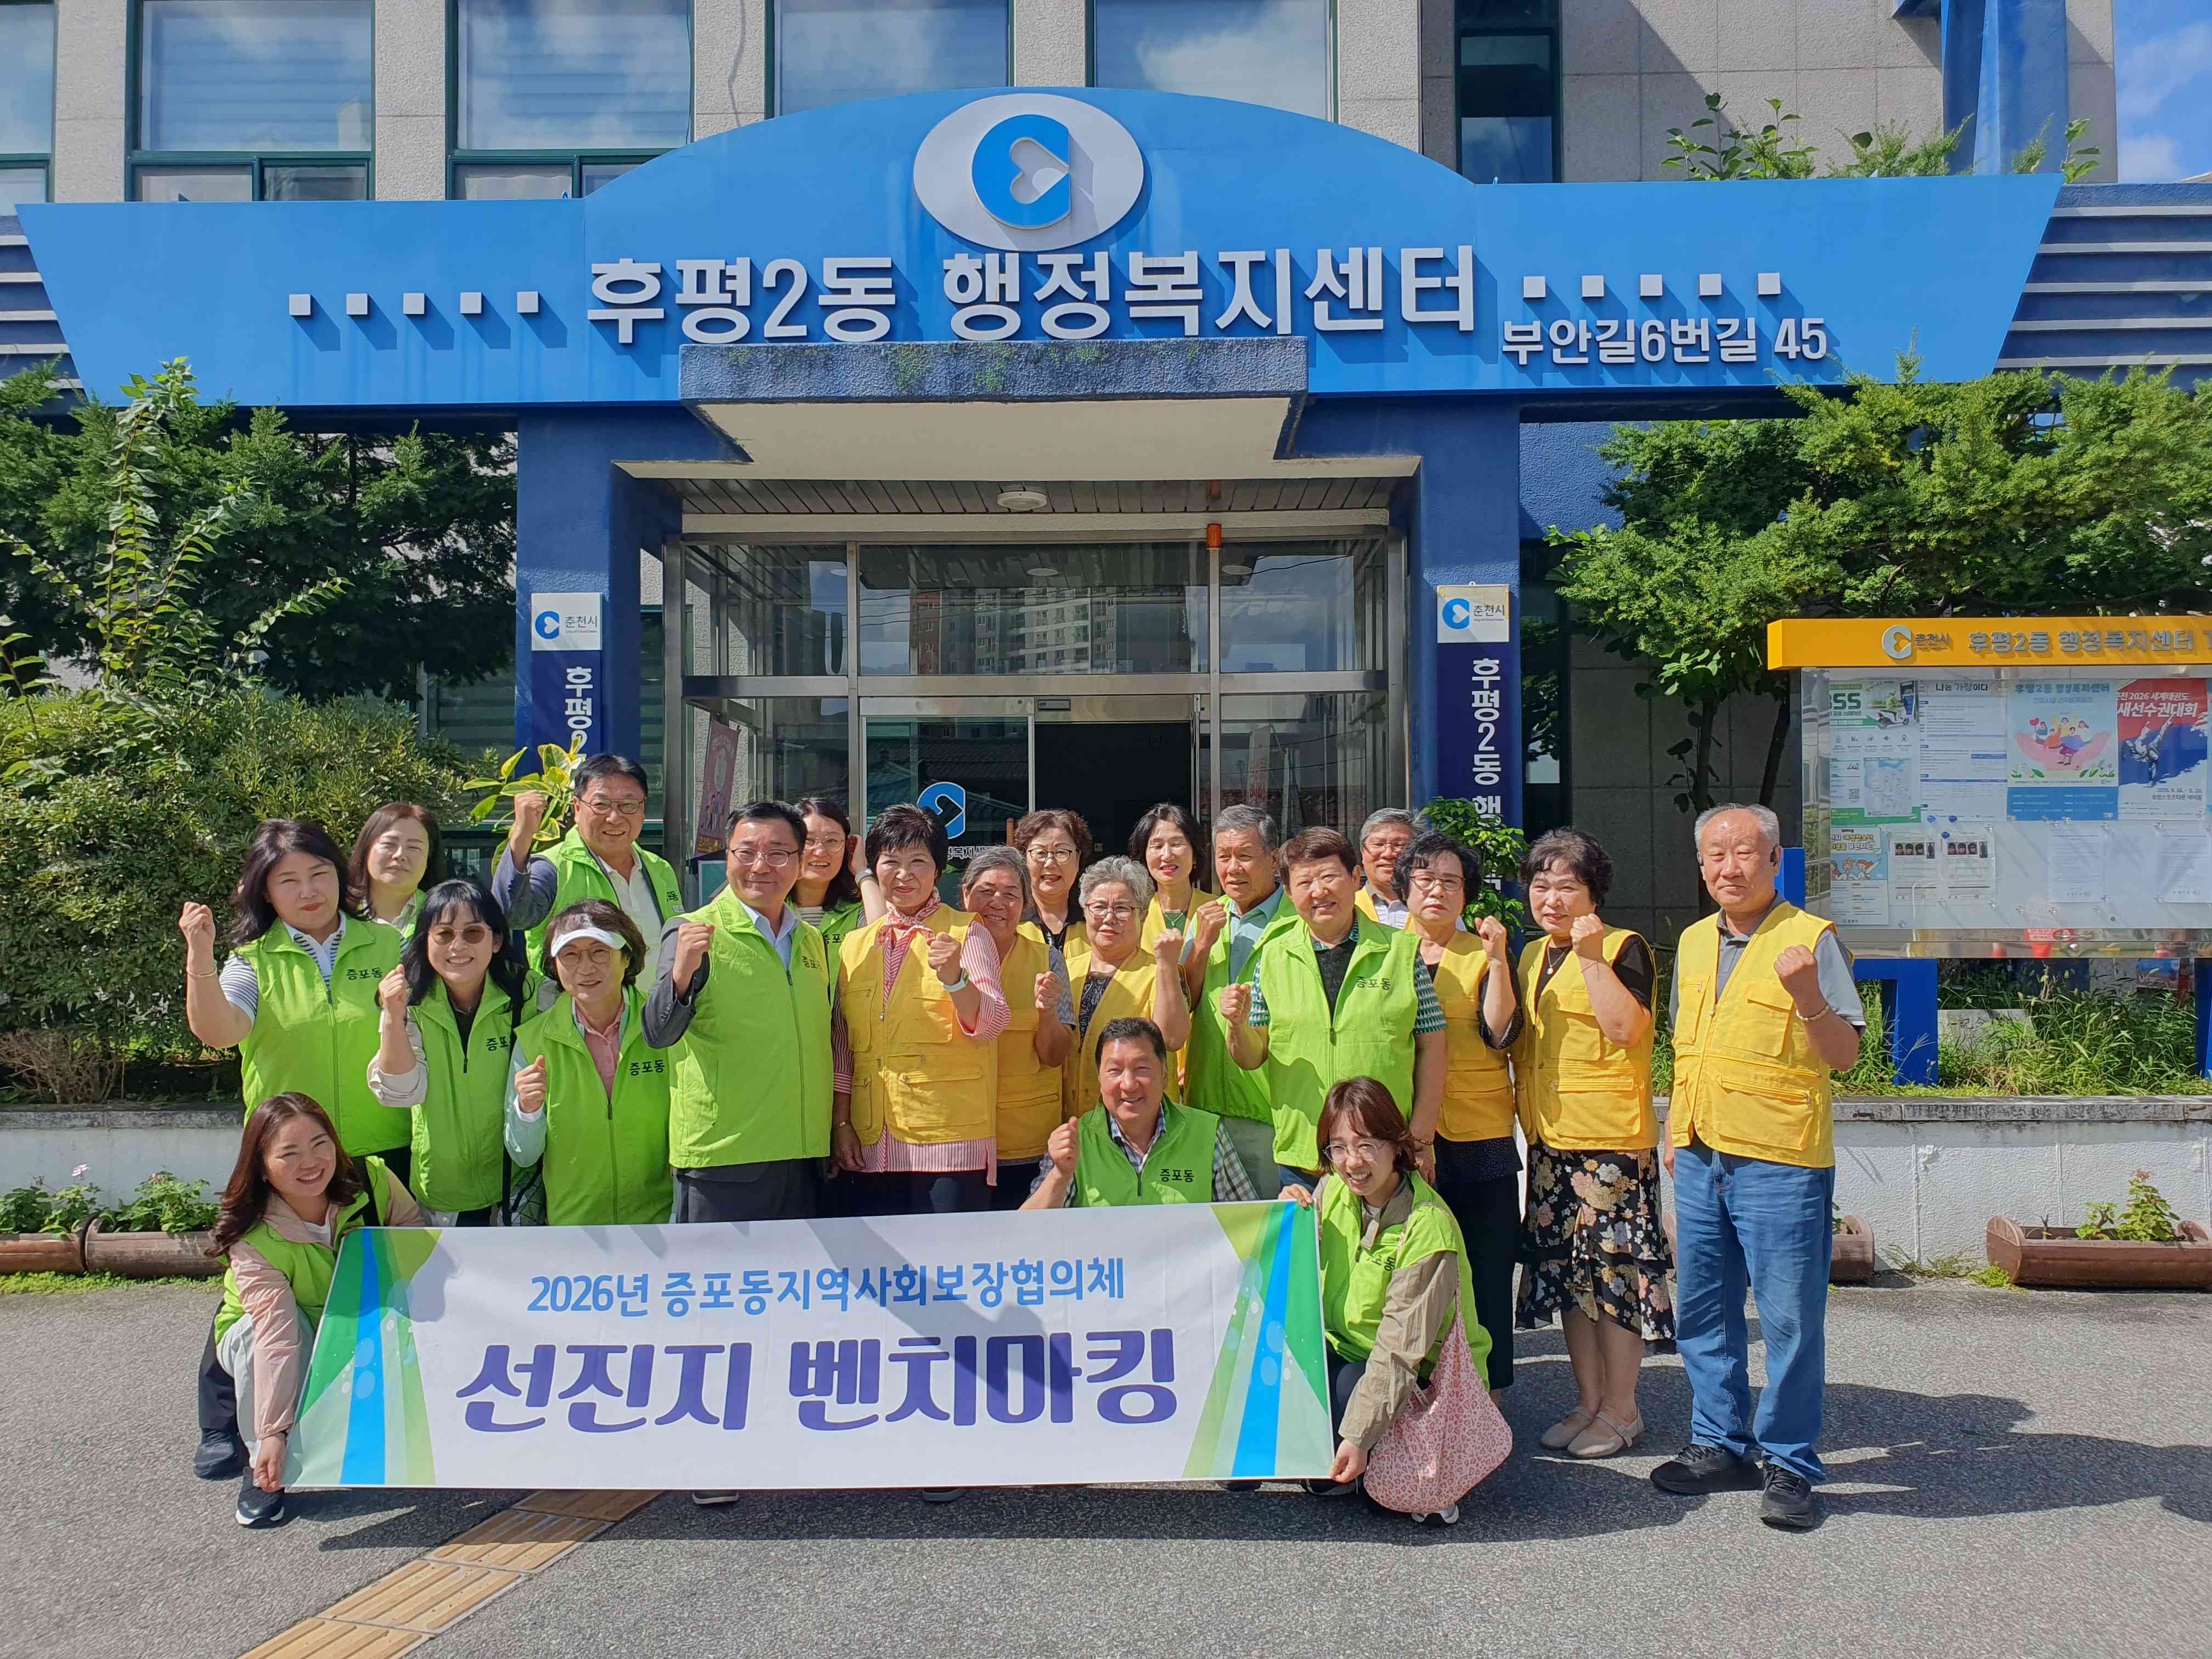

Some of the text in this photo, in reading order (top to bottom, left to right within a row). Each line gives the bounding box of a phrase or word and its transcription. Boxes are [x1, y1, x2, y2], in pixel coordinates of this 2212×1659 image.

[587, 245, 1474, 344] 후평2동 행정복지센터
[1502, 318, 1827, 365] 부안길6번길 45
[1473, 604, 1505, 616] 춘천시
[565, 616, 597, 628] 춘천시
[1968, 631, 2049, 652] 후평2동
[2058, 630, 2194, 652] 행정복지센터
[2129, 692, 2149, 700] 2026
[1471, 658, 1502, 786] 후평2동
[346, 967, 383, 980] 증포동
[1356, 975, 1391, 991] 증포동
[486, 1036, 510, 1051] 증포
[629, 1059, 665, 1076] 증포동
[1160, 1169, 1194, 1183] 증포동
[527, 1257, 1125, 1317] 2026년 증포동지역사회보장협의체
[455, 1328, 1178, 1433] 선진지 벤치마킹
